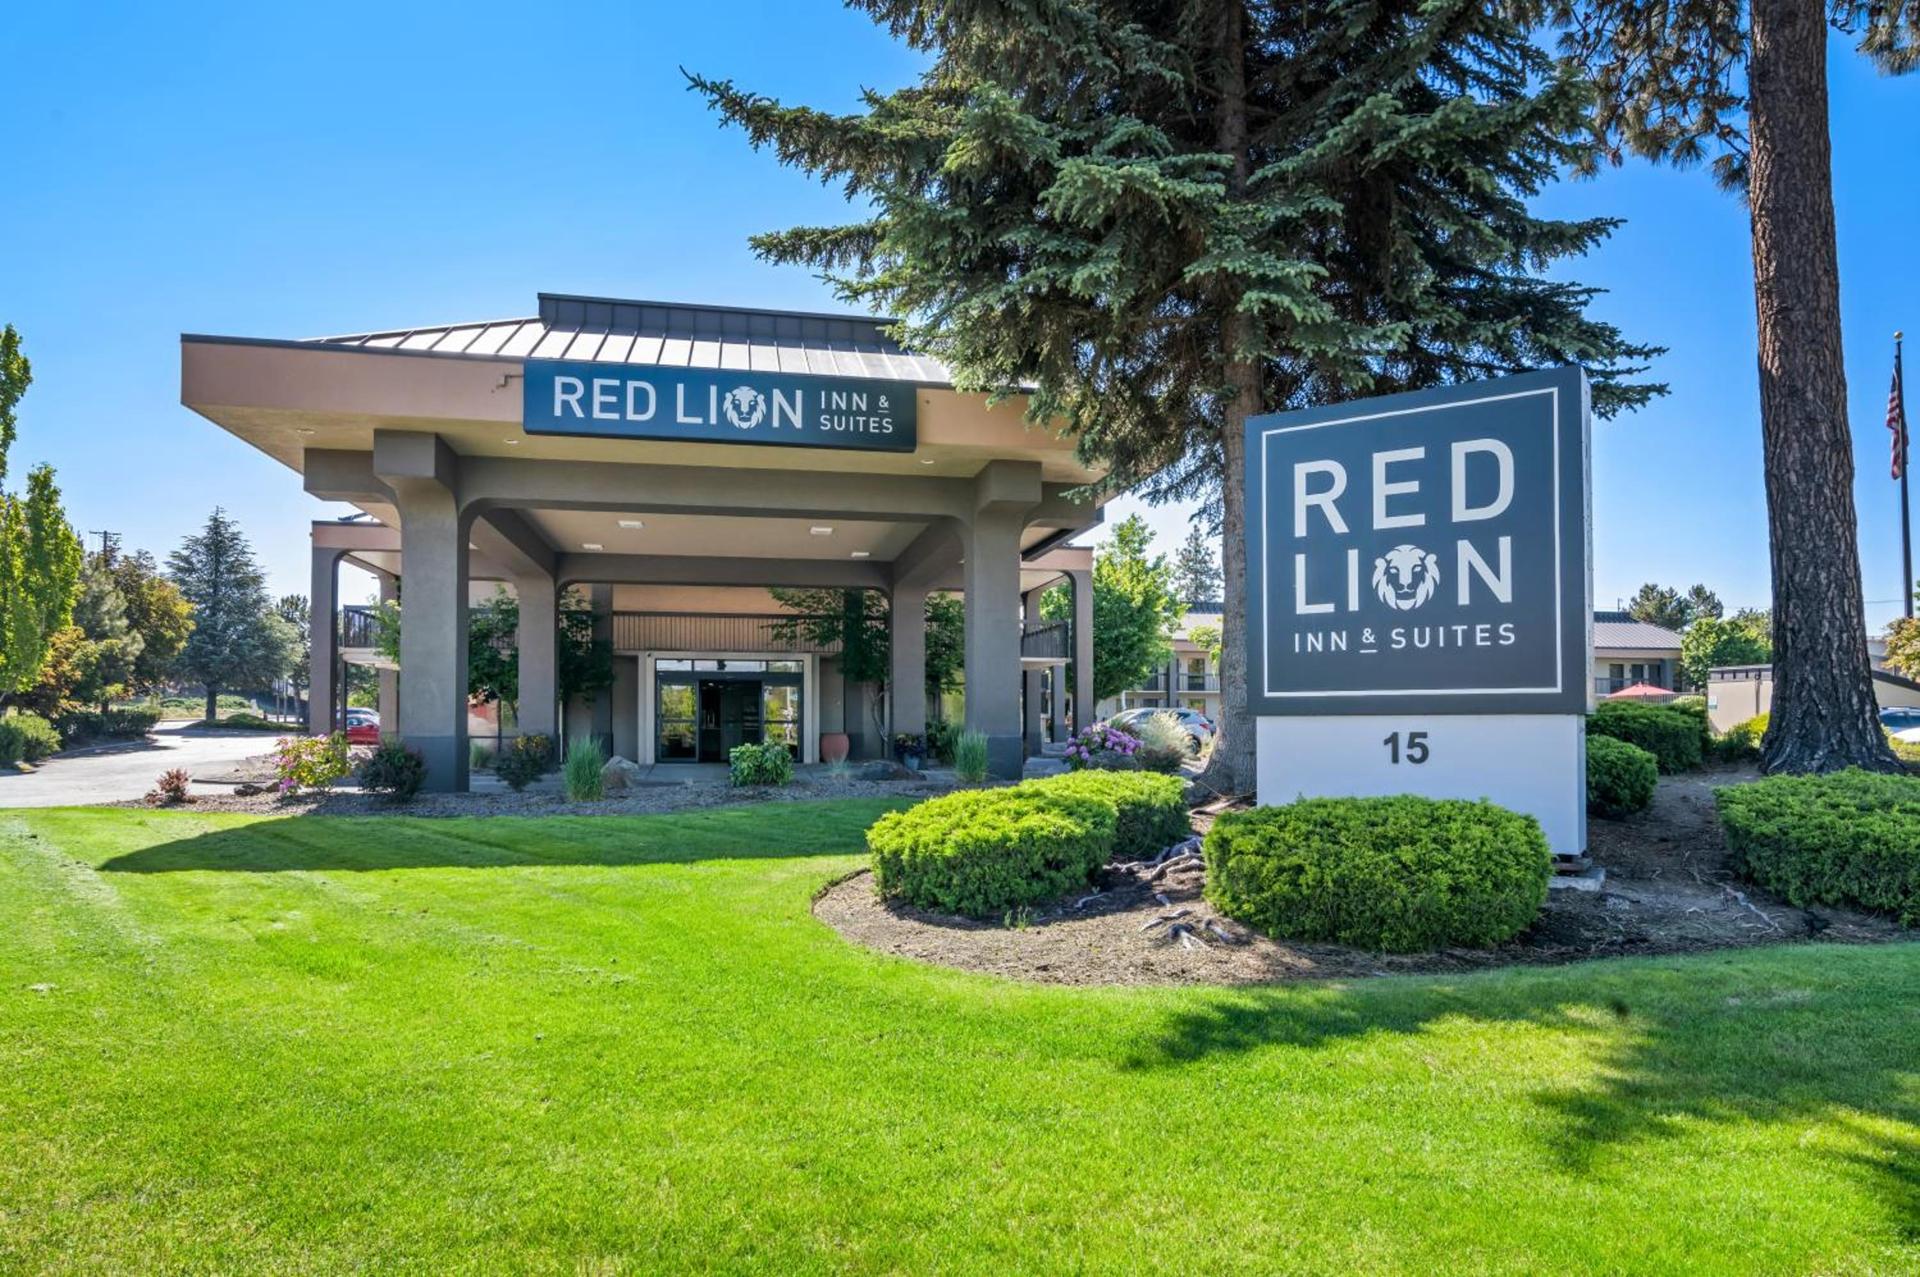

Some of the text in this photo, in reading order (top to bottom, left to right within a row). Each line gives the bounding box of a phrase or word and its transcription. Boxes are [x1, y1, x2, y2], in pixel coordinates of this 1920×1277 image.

[553, 375, 803, 430] RED LION
[820, 390, 890, 413] INN &
[819, 414, 893, 434] SUITES
[1294, 438, 1515, 538] RED
[1295, 535, 1513, 615] LION
[1294, 623, 1516, 654] INN & SUITES
[1383, 731, 1430, 765] 15
